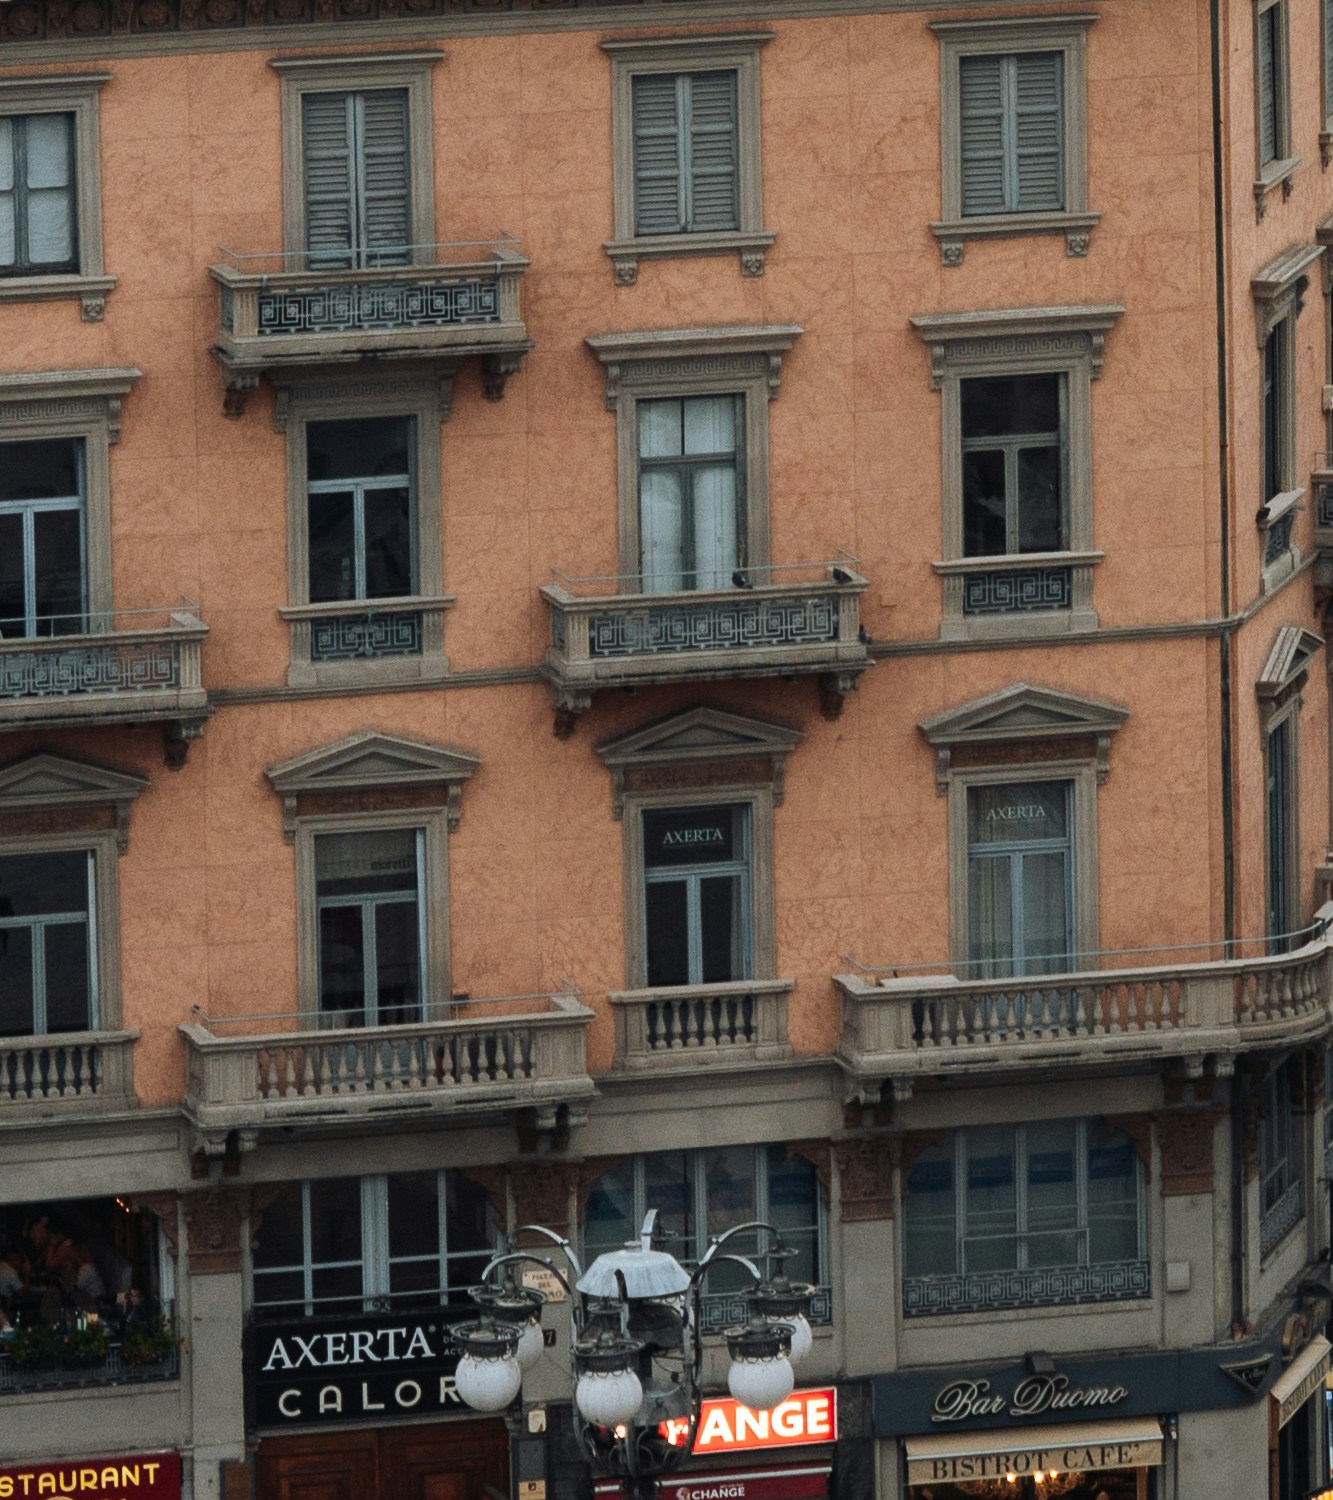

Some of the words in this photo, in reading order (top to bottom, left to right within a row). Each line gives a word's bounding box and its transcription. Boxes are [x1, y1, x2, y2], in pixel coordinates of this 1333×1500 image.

[931, 1380, 1007, 1422] Bar
[1009, 1374, 1129, 1417] Duomo
[930, 1452, 1050, 1480] BISTROT
[692, 1487, 745, 1500] CHANGE
